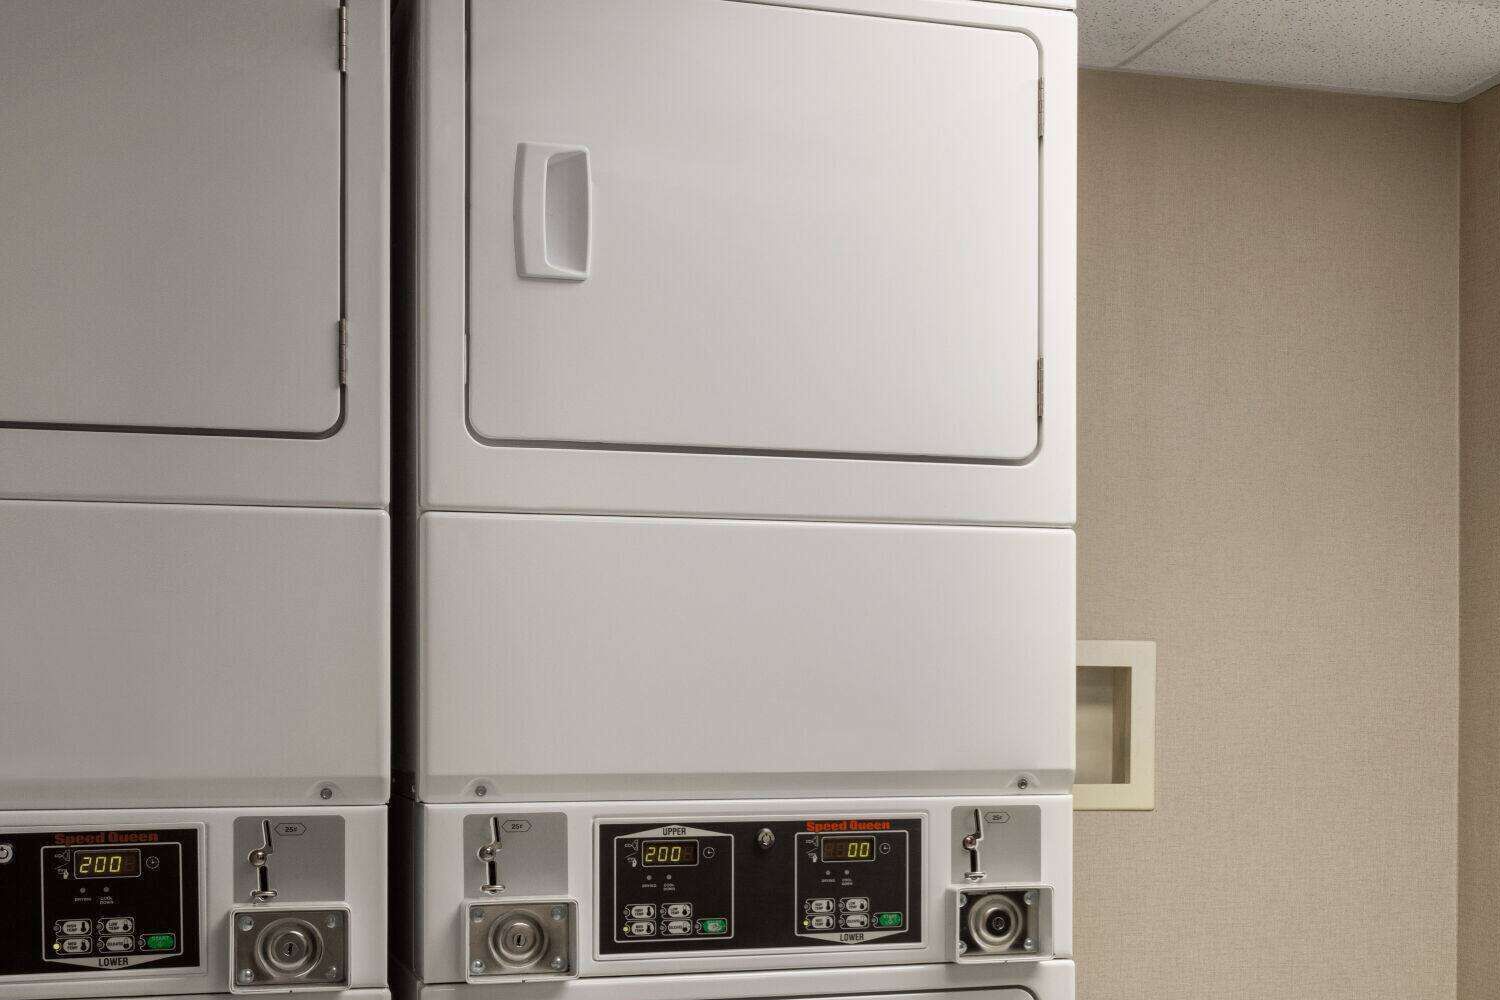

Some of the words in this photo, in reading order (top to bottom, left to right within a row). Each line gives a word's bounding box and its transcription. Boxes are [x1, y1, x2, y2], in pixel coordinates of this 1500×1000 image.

[662, 827, 687, 836] UPPER
[805, 820, 847, 832] Speed
[849, 819, 890, 830] Queen
[54, 831, 105, 846] Speed
[108, 830, 159, 845] Queen
[645, 846, 682, 862] 200
[847, 842, 870, 858] 00
[80, 856, 122, 873] 200
[840, 933, 864, 942] LOWER
[98, 957, 129, 967] LOWER
